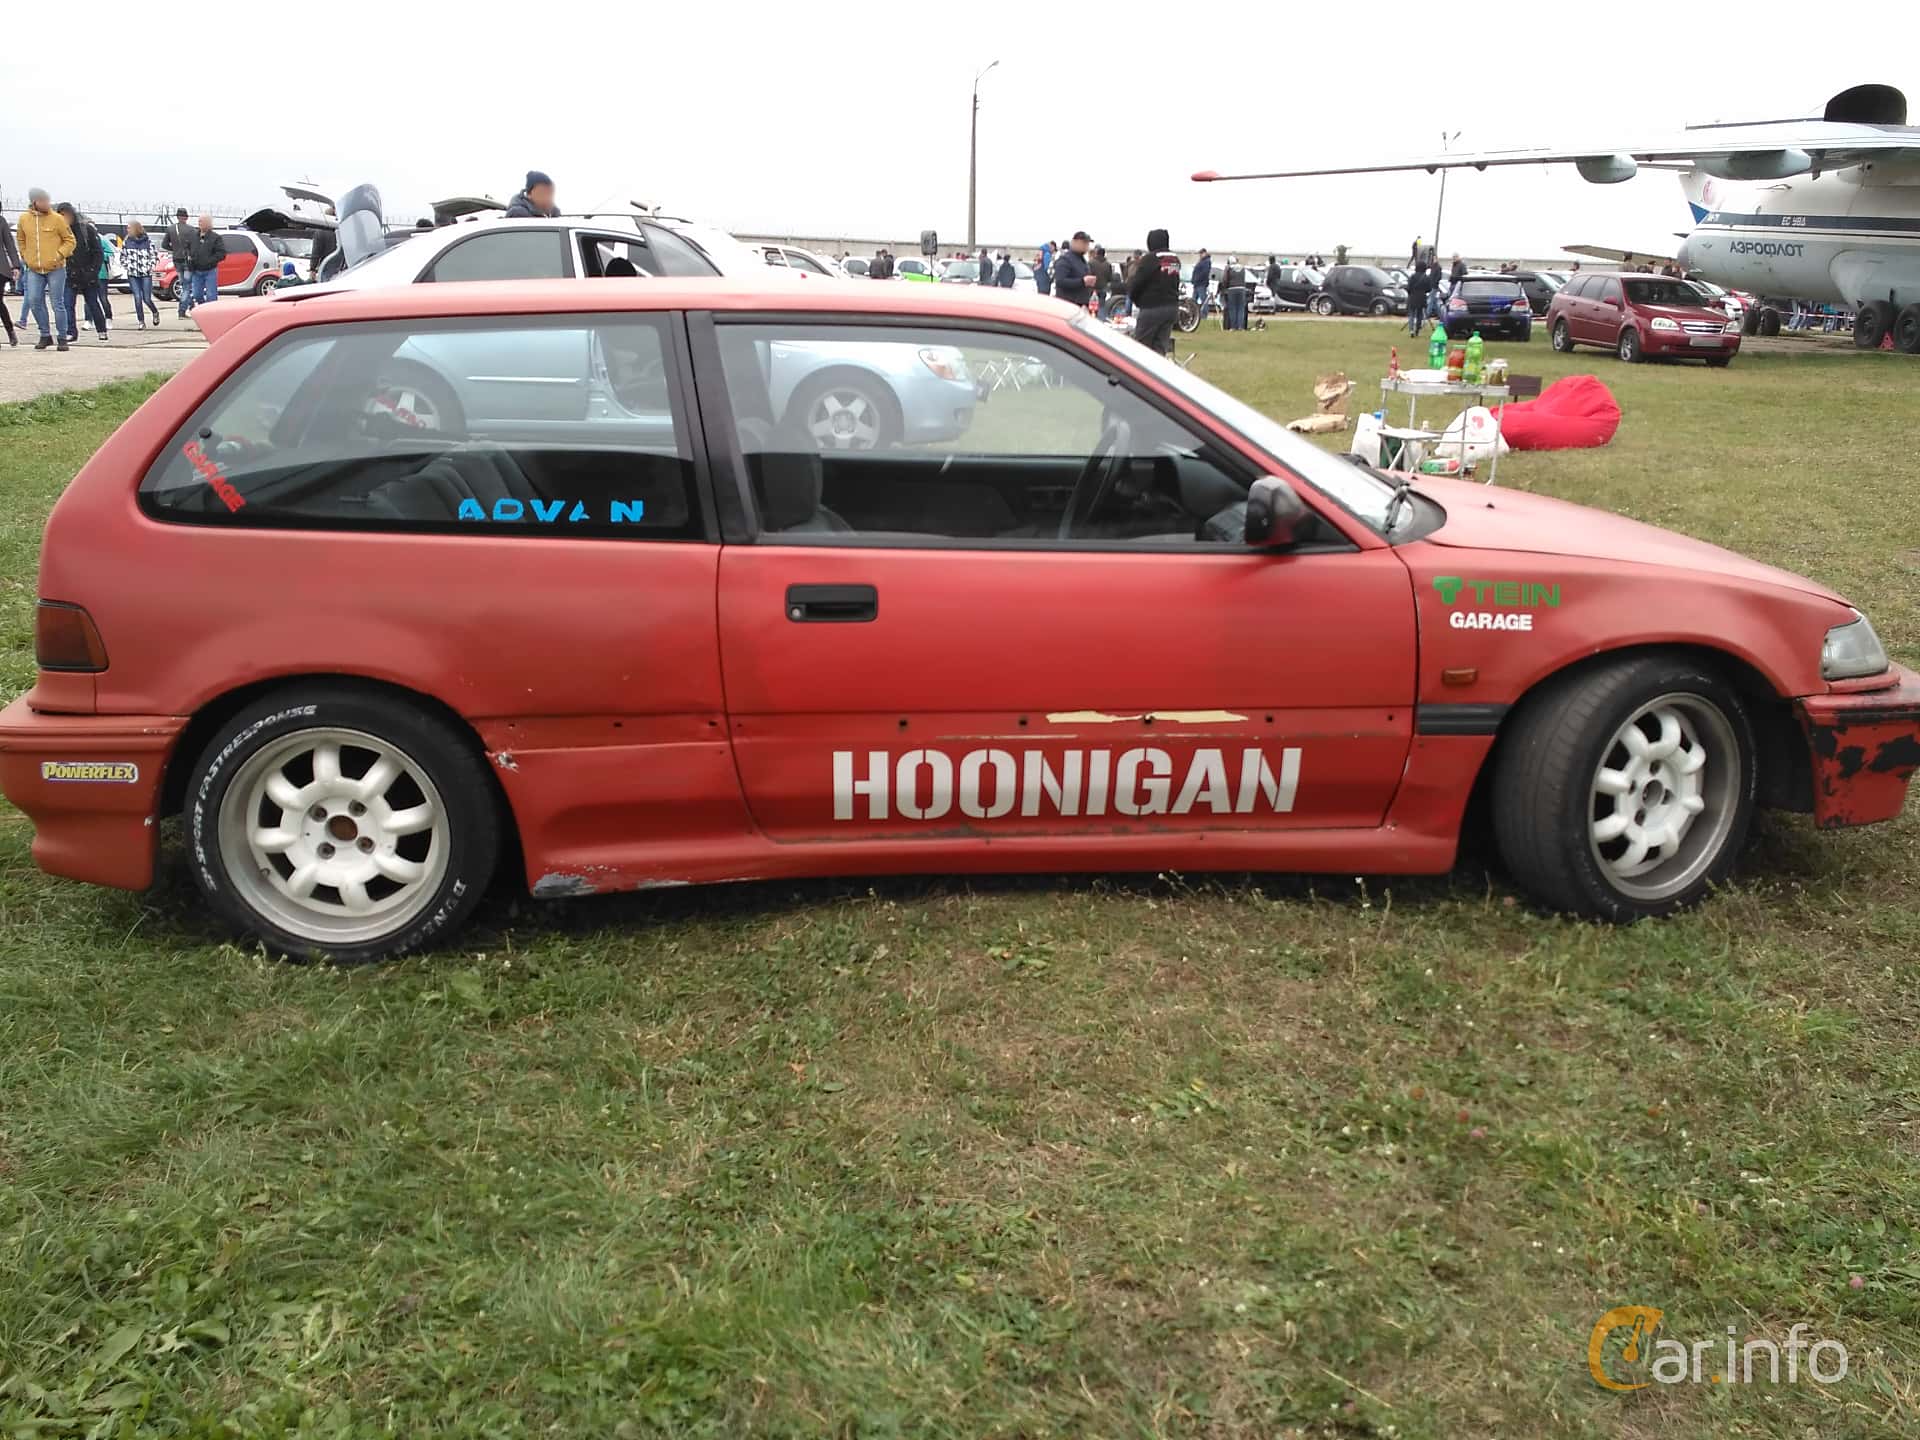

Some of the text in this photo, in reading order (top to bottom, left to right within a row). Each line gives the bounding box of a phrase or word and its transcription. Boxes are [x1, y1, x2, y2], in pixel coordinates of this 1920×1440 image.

[1730, 241, 1804, 257] АЭРОФЛОТ
[182, 441, 247, 513] GARAGE
[1468, 580, 1560, 608] TEIN
[1449, 611, 1533, 631] GARAGE
[43, 763, 134, 780] POWERFLEX
[832, 747, 1302, 820] HOONIGAN
